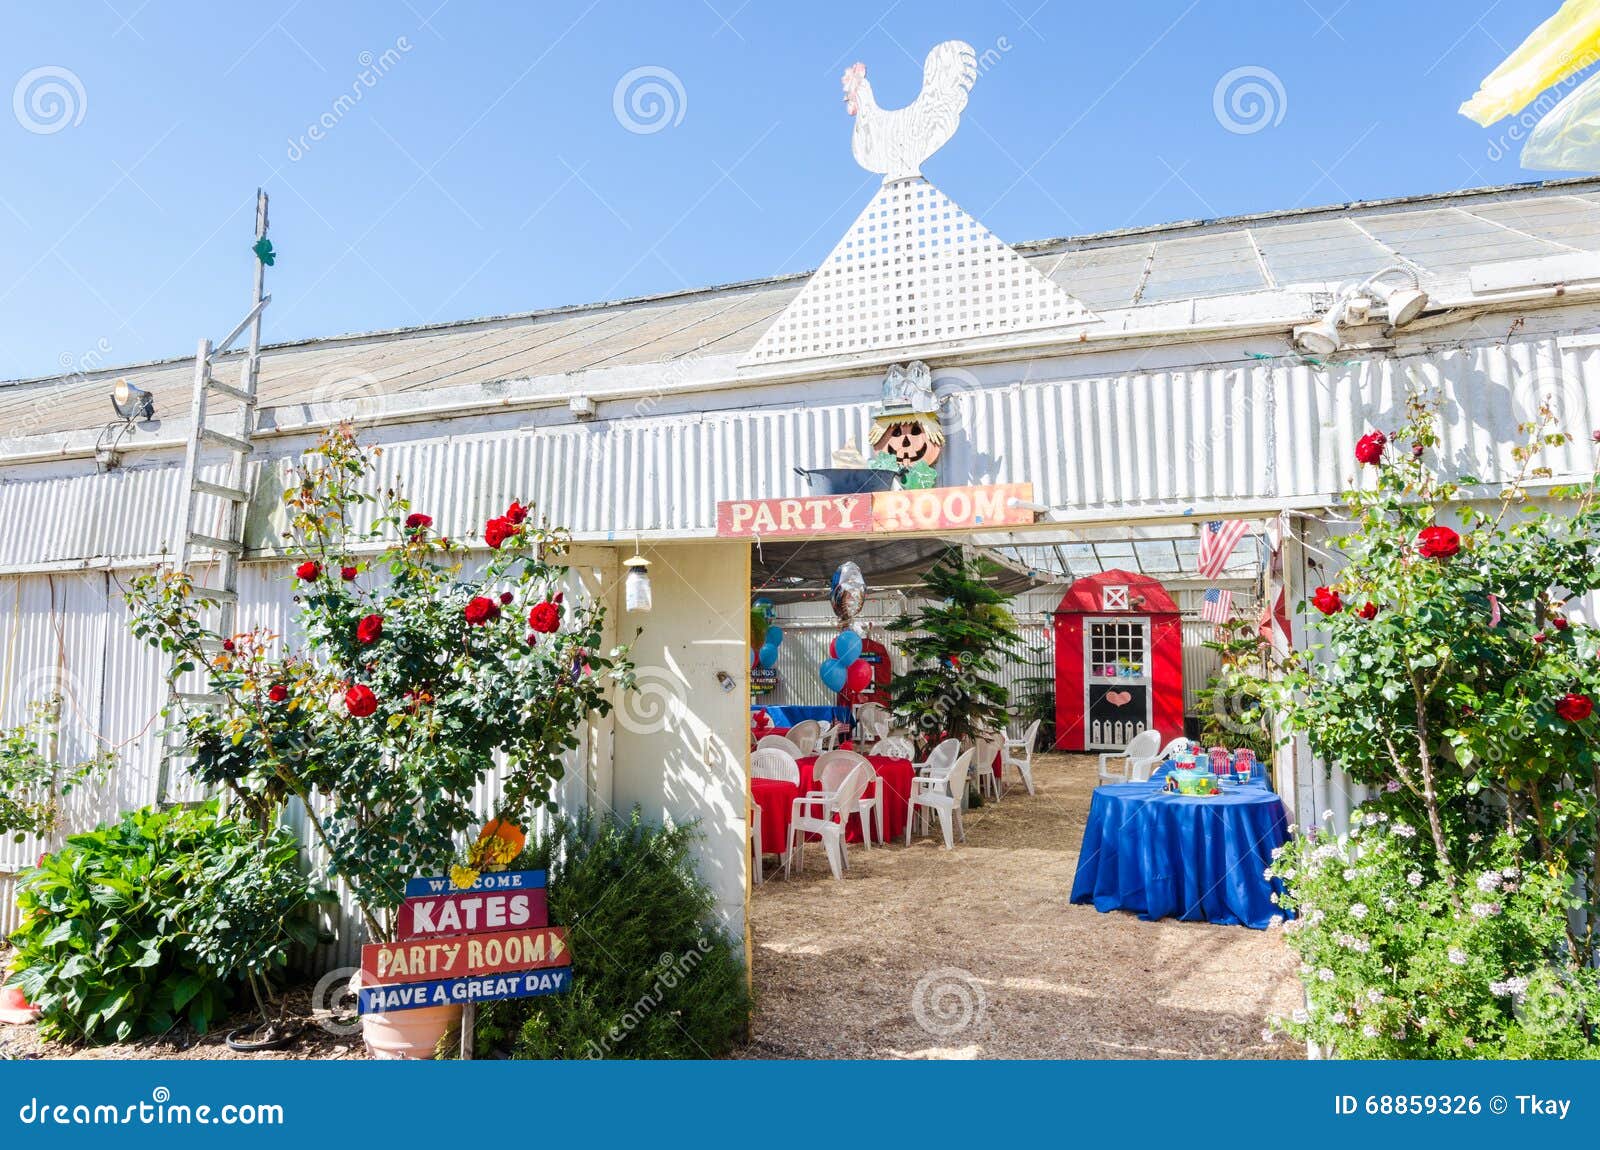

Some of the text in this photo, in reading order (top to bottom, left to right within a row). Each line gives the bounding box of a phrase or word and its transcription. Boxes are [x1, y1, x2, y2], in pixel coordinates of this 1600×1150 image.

[730, 490, 1006, 533] PARTY ROOM
[428, 875, 523, 892] WECOME
[412, 895, 531, 934] KATES
[377, 934, 546, 978] PARTY ROOM
[369, 972, 564, 1009] HAVE A GREAT DAY
